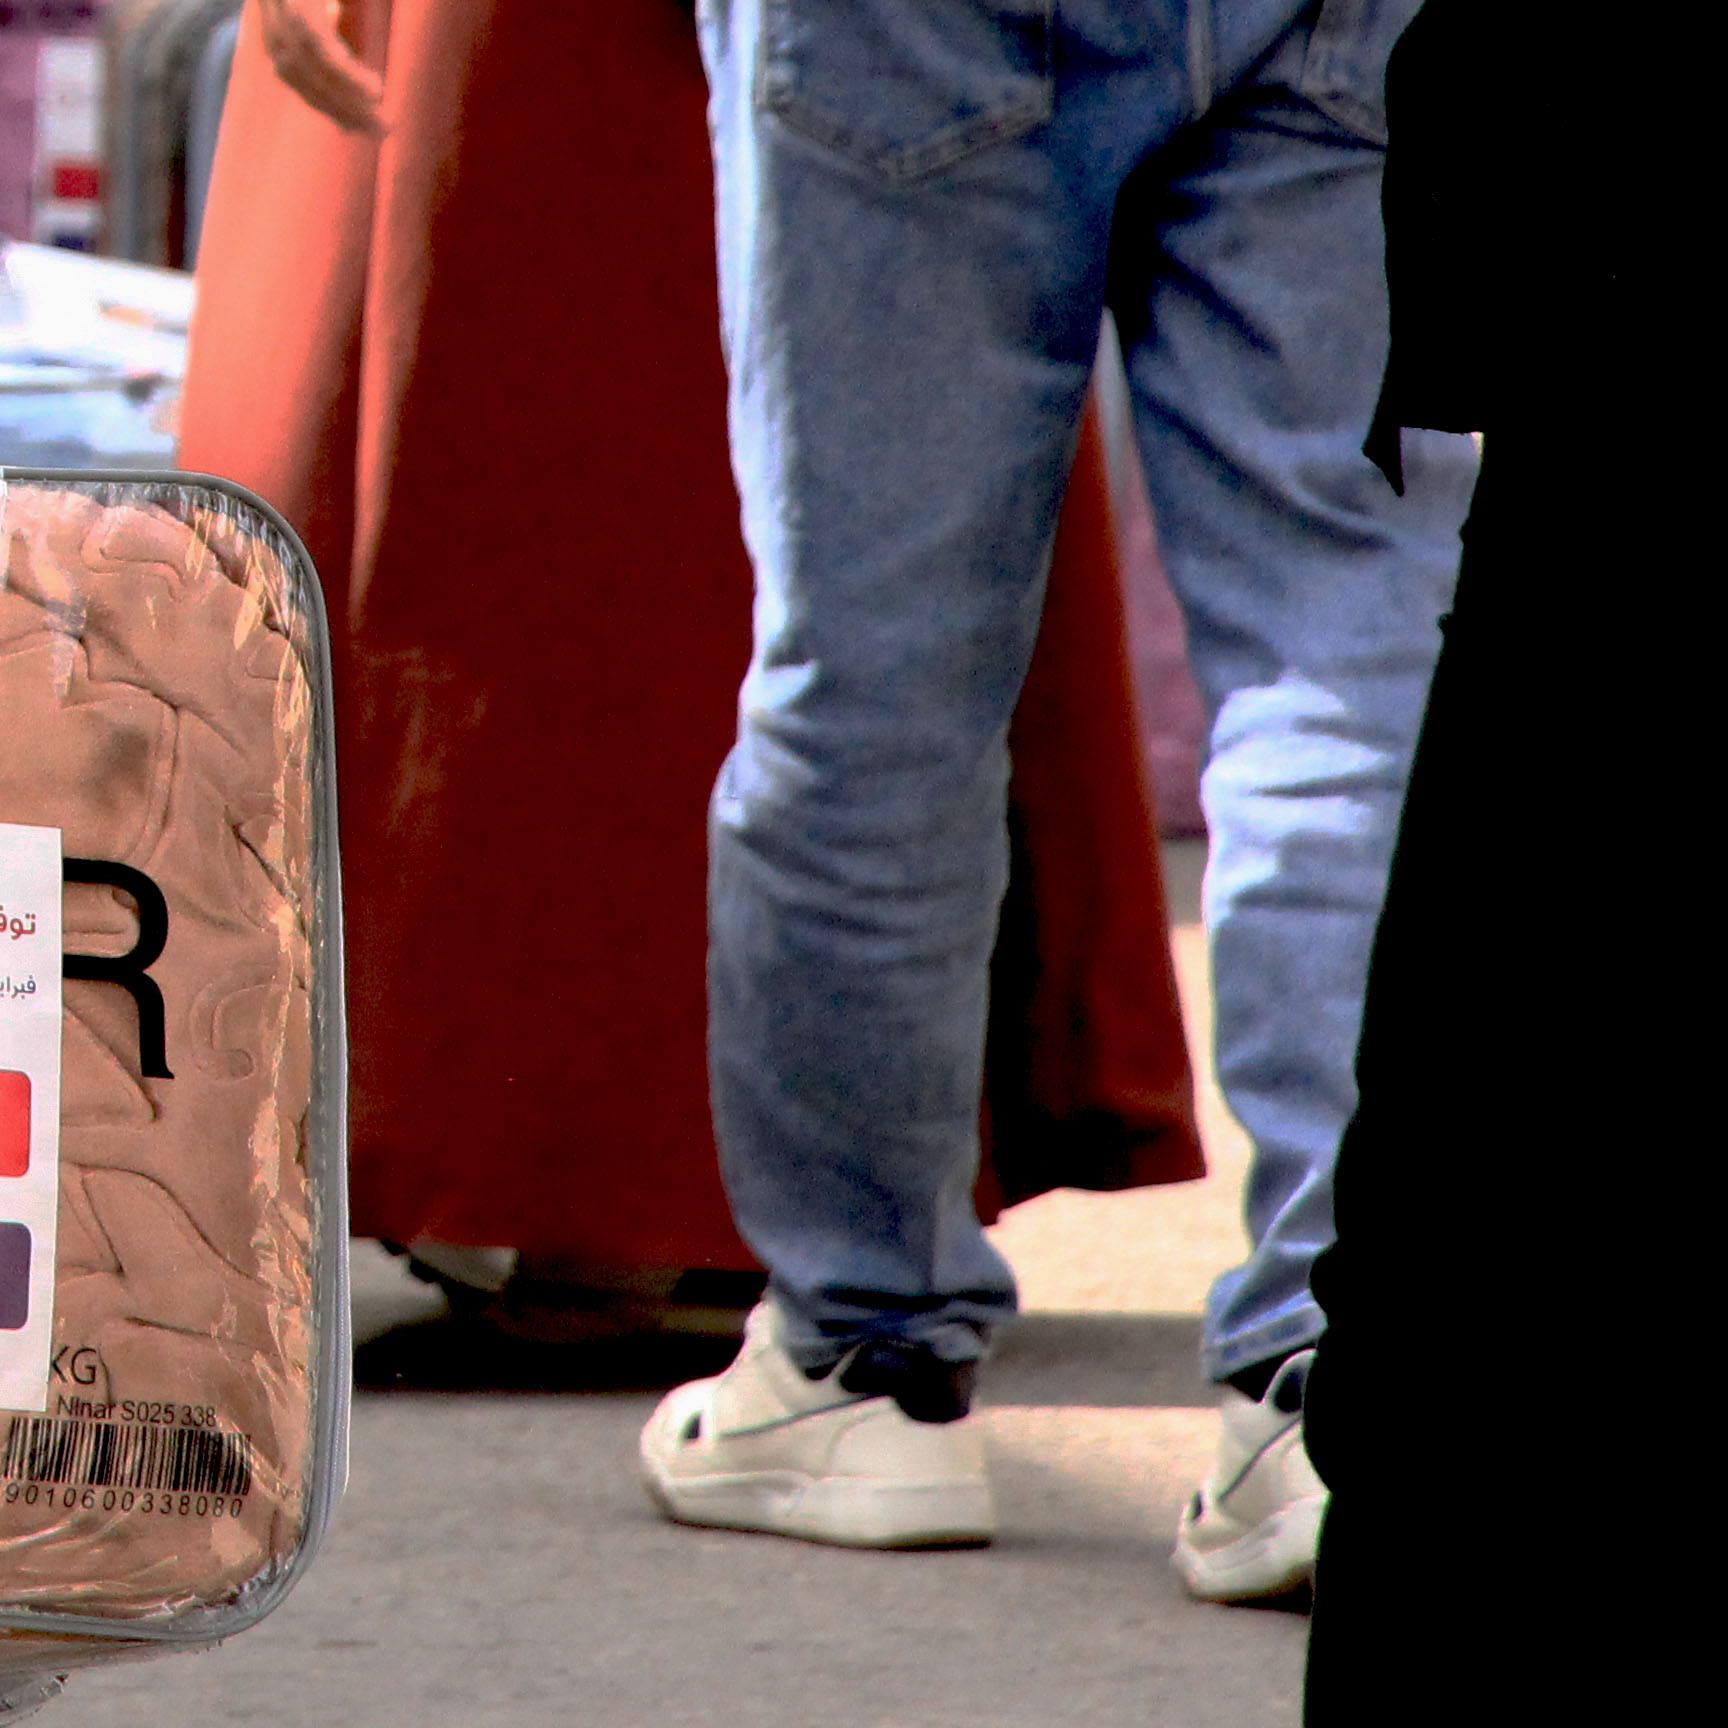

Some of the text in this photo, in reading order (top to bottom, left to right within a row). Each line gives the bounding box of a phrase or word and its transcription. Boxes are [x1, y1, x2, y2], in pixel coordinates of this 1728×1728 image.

[121, 1399, 176, 1425] S025
[180, 1404, 218, 1428] 338
[5, 1481, 244, 1519] 9010600338080
